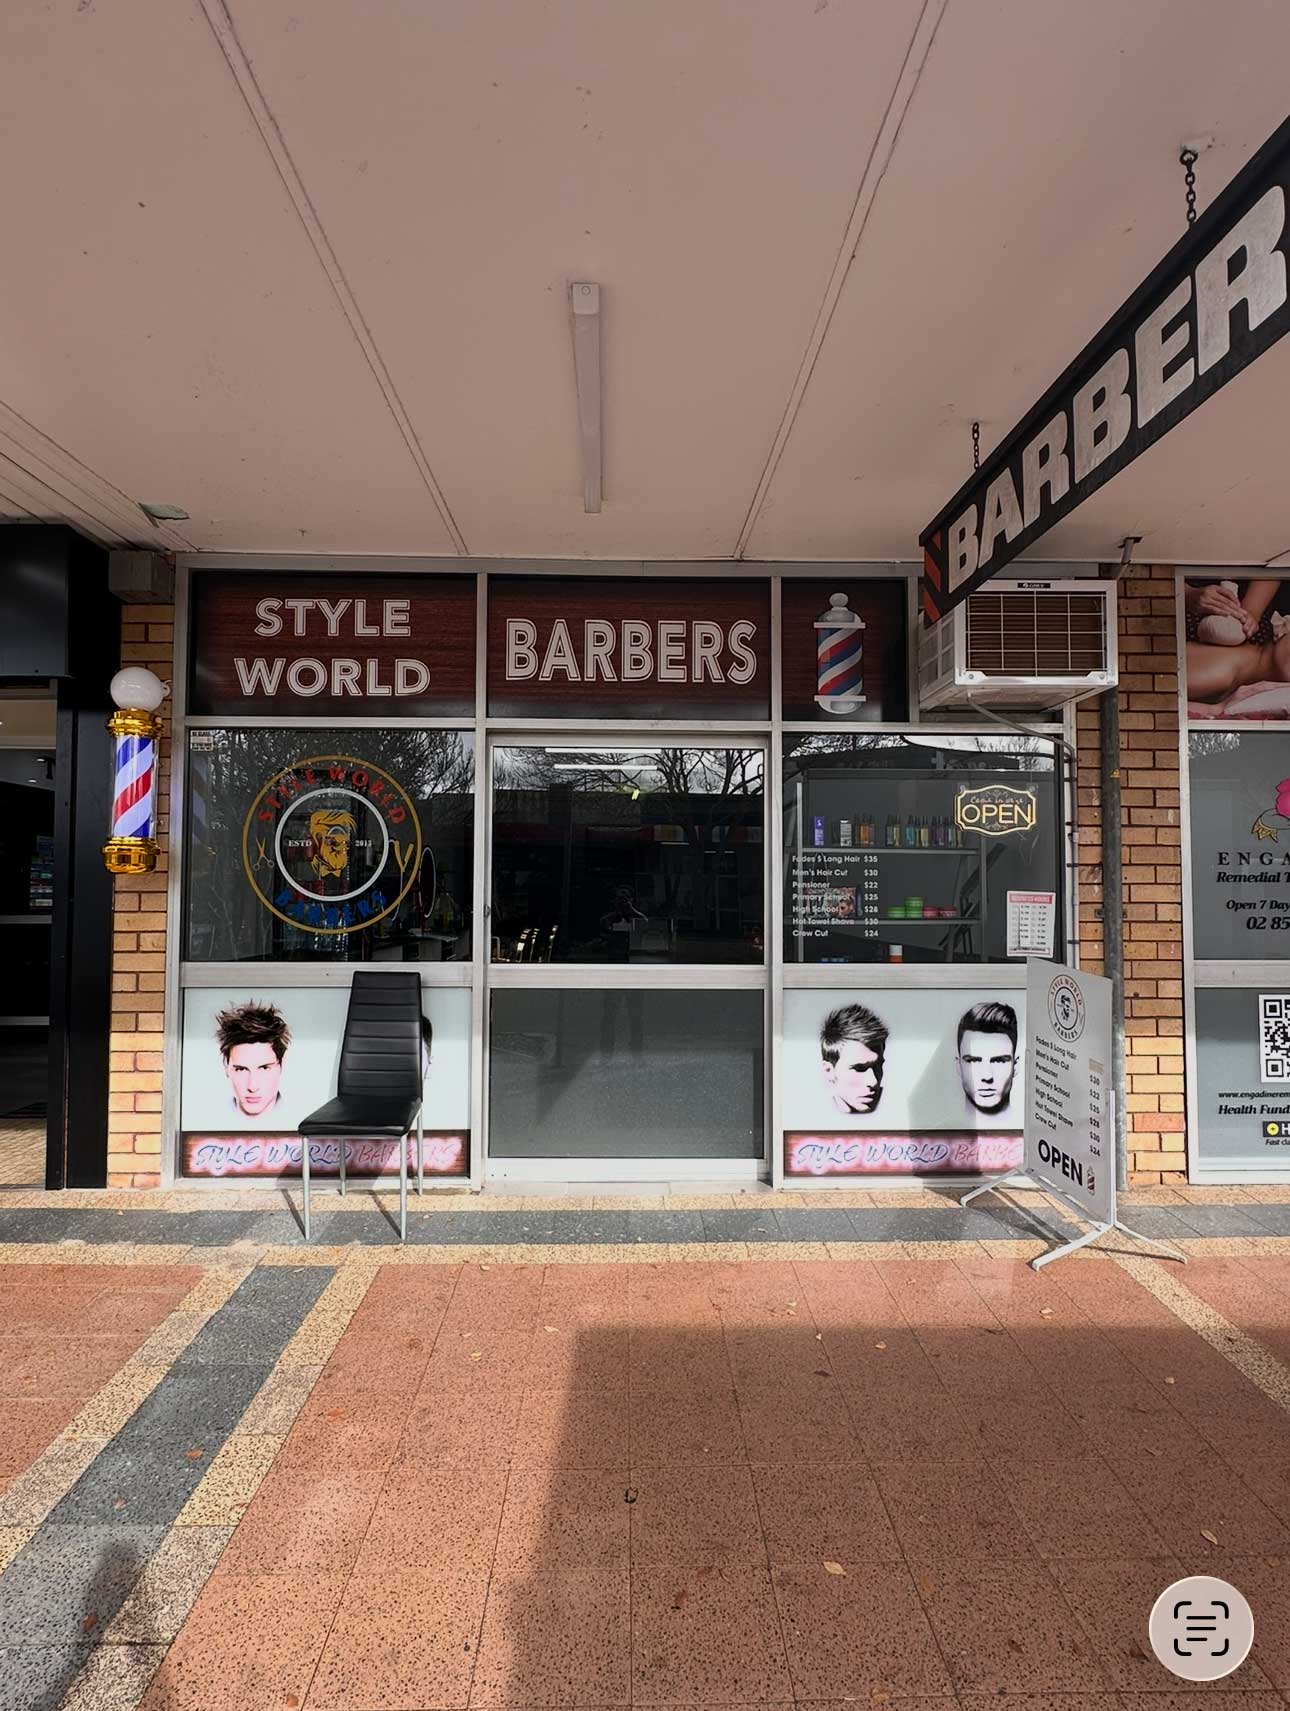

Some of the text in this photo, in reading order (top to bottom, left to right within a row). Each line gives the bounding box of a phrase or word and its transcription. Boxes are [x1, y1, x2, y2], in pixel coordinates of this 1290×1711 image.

[948, 185, 1289, 594] BARBER
[254, 598, 411, 638] STYLE
[505, 617, 758, 685] BARBERS
[233, 657, 431, 697] WORLD
[328, 766, 407, 824] WORLD
[961, 803, 1031, 824] OPEN
[288, 839, 312, 847] ESTD
[823, 855, 843, 864] Long
[844, 855, 860, 863] Hair
[863, 855, 878, 863] $35
[1217, 851, 1290, 866] ENGA
[792, 868, 815, 876] Men's
[834, 868, 848, 876] Cut
[864, 868, 879, 876] $30
[1216, 871, 1281, 883] Remedial
[792, 881, 879, 889] Pensioner $22
[792, 893, 822, 902] Primary
[864, 893, 879, 901] $25
[792, 905, 811, 914] High
[812, 905, 839, 913] School
[1226, 899, 1290, 912] Open 7 Day
[807, 917, 830, 925] Towel
[864, 917, 879, 925] $30
[1246, 916, 1290, 930] 02 85
[792, 929, 879, 937] Crew Cut $24
[1060, 1060, 1069, 1070] Cut
[1053, 1084, 1070, 1099] School
[1047, 1093, 1063, 1108] School
[1218, 1104, 1290, 1114] Health Fund
[1047, 1120, 1057, 1130] Cut
[1265, 1138, 1281, 1146] Fast
[196, 1144, 261, 1170] STYLE
[268, 1144, 352, 1165] WORLD
[797, 1143, 860, 1169] STYLE
[867, 1143, 950, 1164] WORLD
[1037, 1138, 1083, 1186] OPEN
